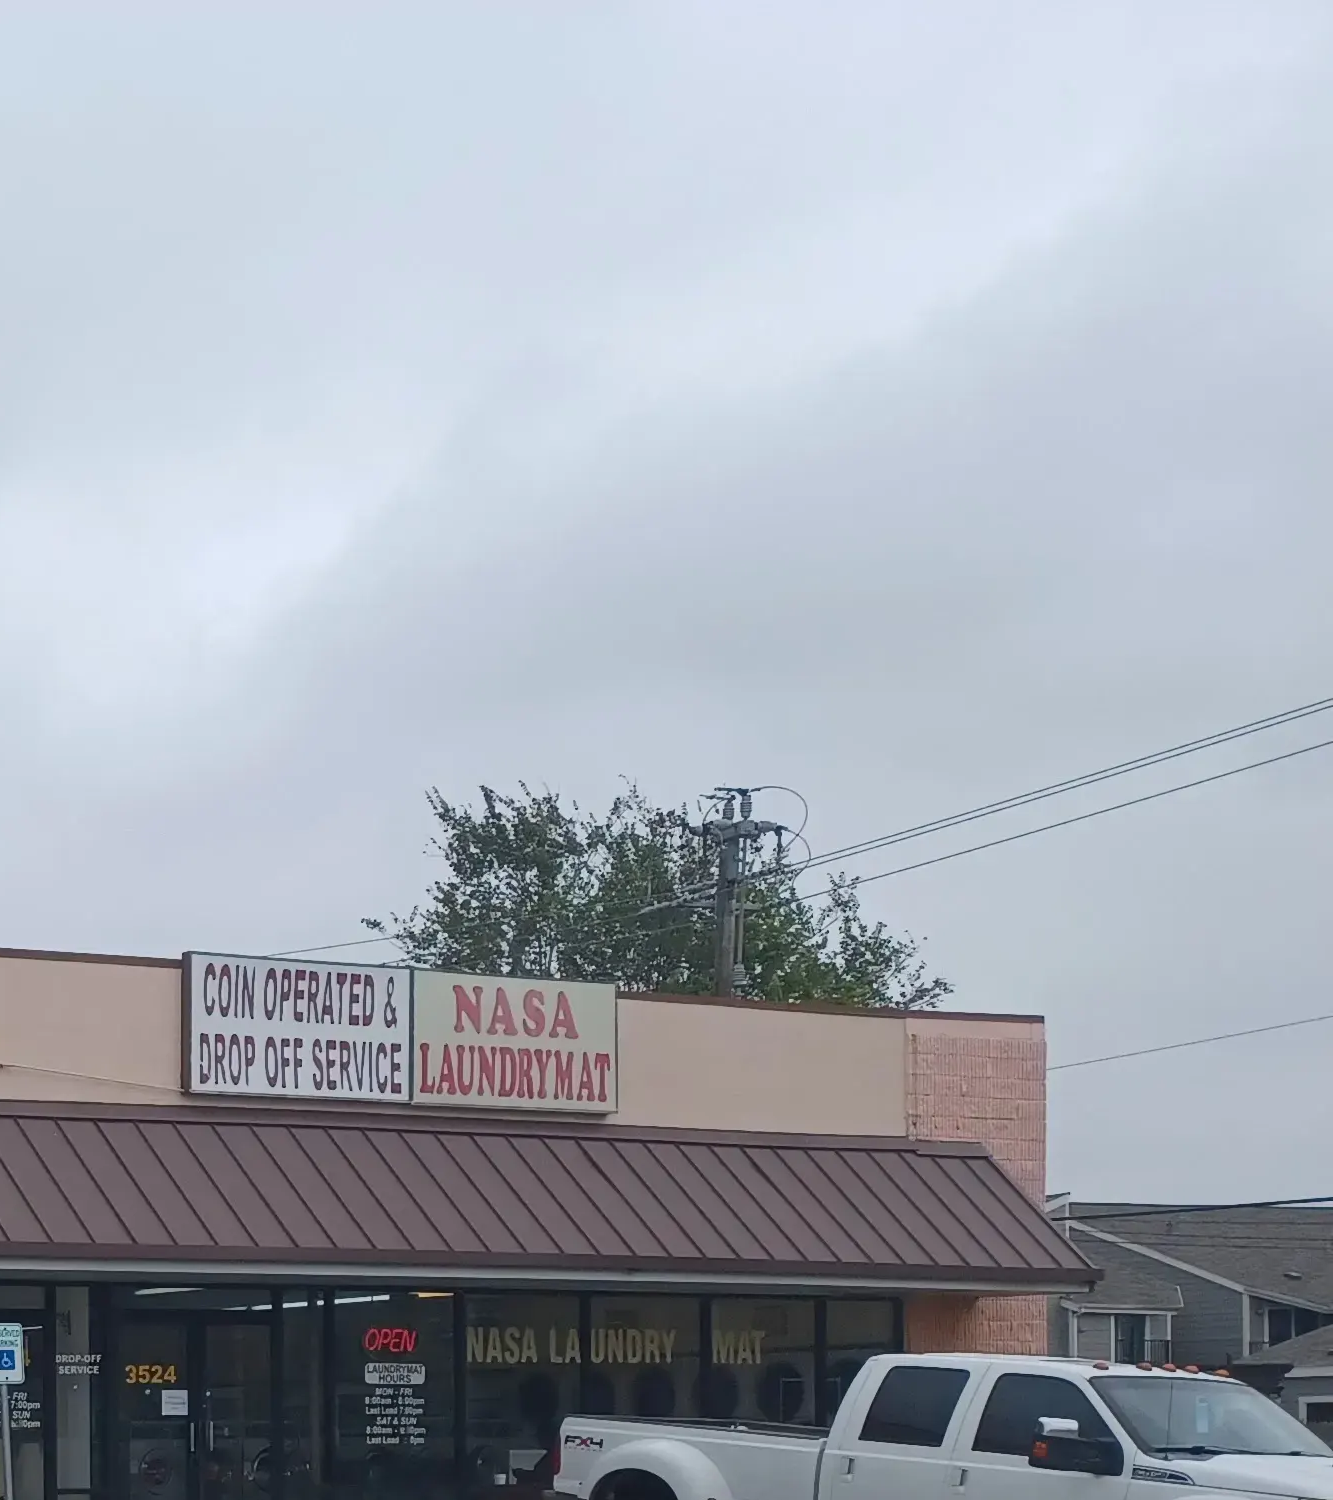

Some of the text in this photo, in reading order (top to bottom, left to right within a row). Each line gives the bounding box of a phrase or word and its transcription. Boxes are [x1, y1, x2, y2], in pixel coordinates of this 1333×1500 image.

[203, 962, 398, 1028] COIN OPERATED &
[452, 984, 579, 1040] NASA
[199, 1032, 403, 1094] DROP OFF SERVICE
[419, 1042, 611, 1102] LAUNDRYMAT
[364, 1328, 417, 1352] OPEN
[465, 1326, 538, 1364] NASA
[712, 1329, 765, 1365] MAT
[55, 1354, 102, 1363] DROP-OFF
[366, 1364, 423, 1374] LAUNDRYMAT
[58, 1365, 100, 1375] SERVICE
[125, 1364, 177, 1384] 3524
[378, 1374, 412, 1383] HOURS
[564, 1434, 604, 1449] FX4
